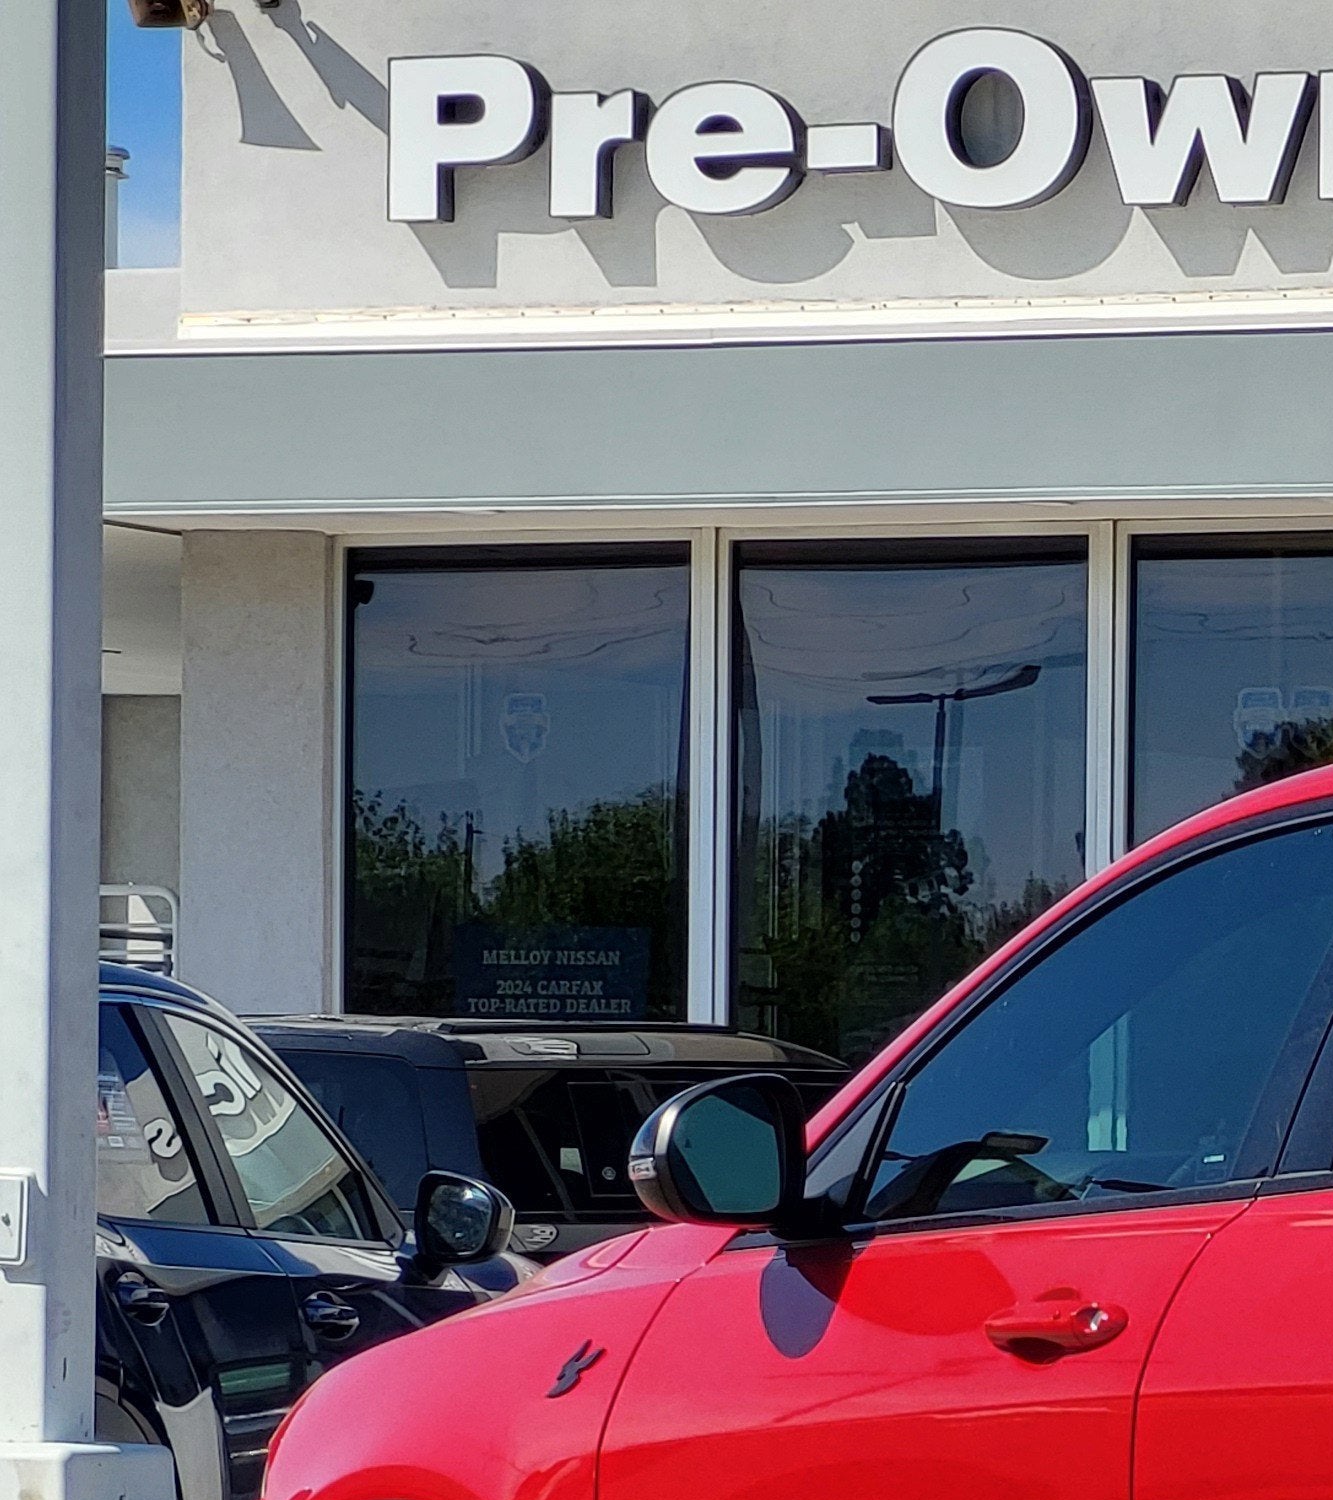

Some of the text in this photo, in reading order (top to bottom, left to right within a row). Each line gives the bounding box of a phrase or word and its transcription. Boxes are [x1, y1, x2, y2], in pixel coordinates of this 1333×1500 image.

[483, 949, 621, 966] MELLOY NISSAN
[496, 980, 604, 996] 2024 CARFAX
[468, 997, 632, 1014] TOP-RATED DEALER
